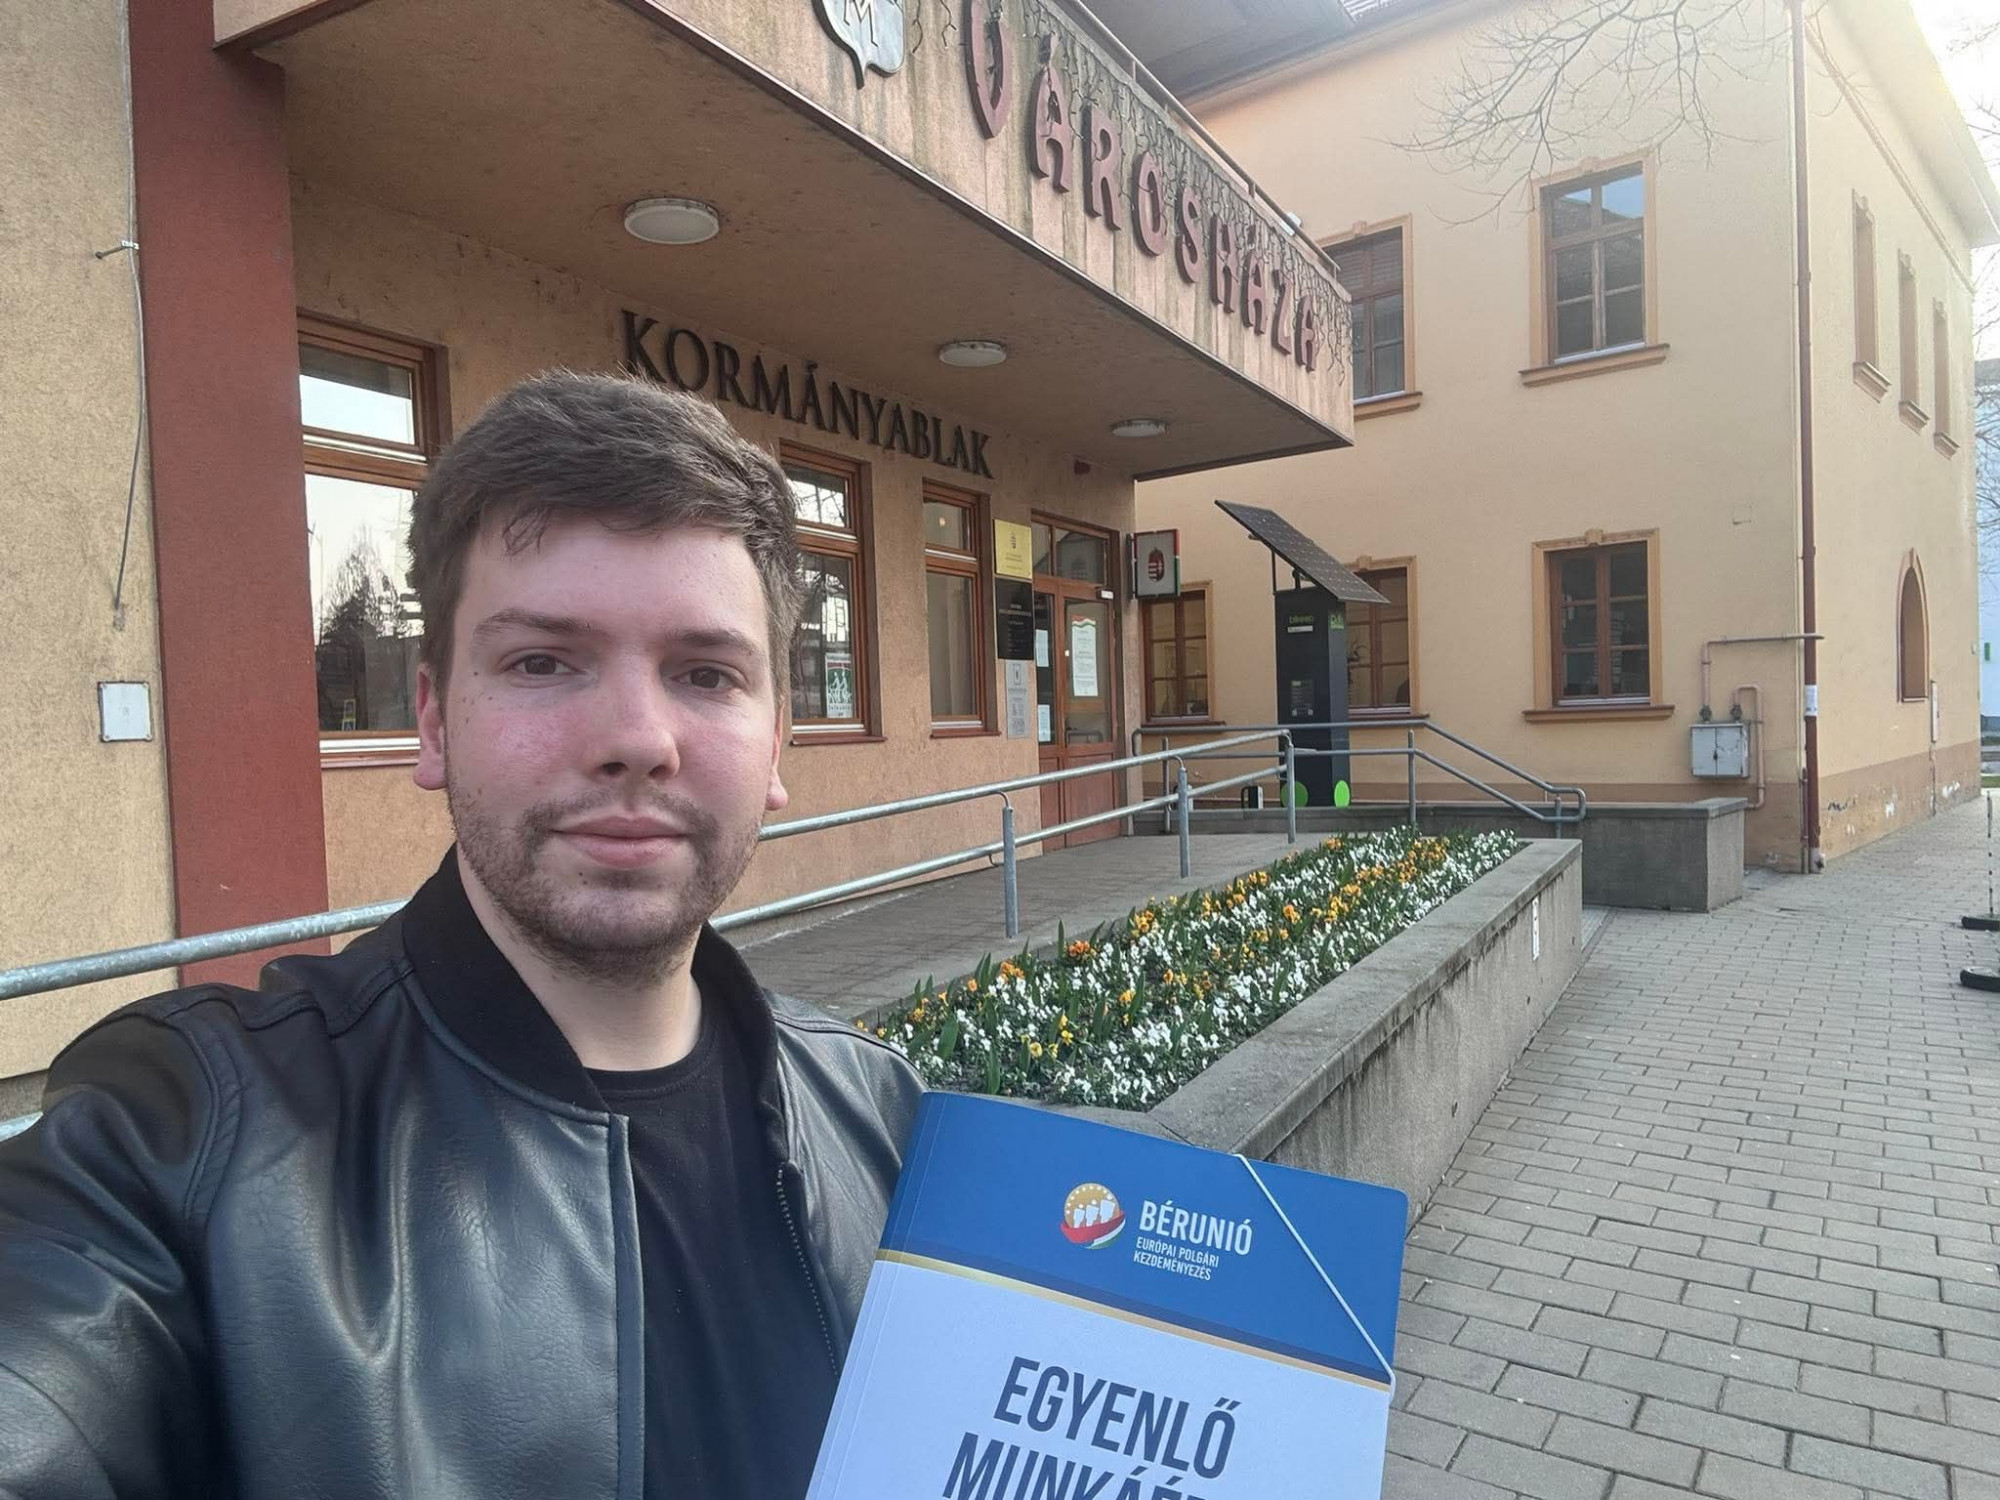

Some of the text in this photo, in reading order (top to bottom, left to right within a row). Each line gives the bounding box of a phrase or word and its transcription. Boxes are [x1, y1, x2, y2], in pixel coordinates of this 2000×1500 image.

[621, 309, 993, 479] KORMÁNYABLAK
[1136, 1236, 1220, 1268] EURÓPAI POLGÁRI
[1139, 1200, 1254, 1256] BÉRUNIÓ
[1133, 1250, 1212, 1281] KEZDEMÉNYEZÉS
[993, 1355, 1242, 1480] EGYENLŐ
[942, 1431, 1206, 1500] MUNK
